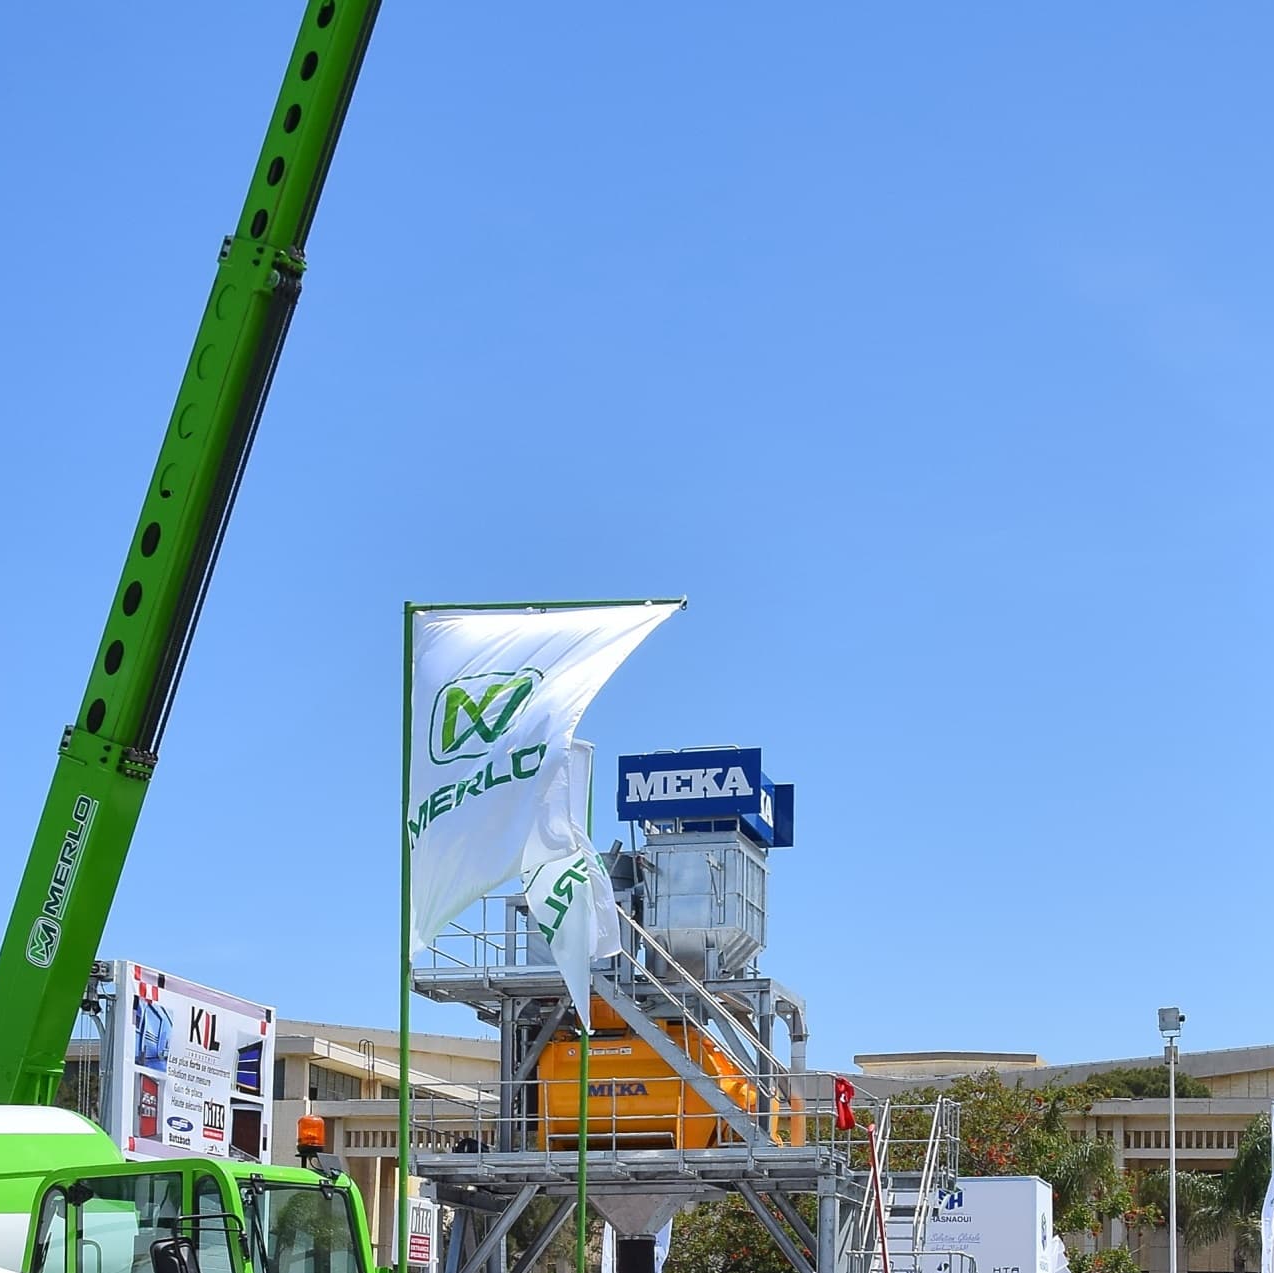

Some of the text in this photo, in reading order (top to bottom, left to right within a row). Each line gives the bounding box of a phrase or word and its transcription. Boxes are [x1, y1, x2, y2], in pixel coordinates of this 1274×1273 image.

[626, 767, 754, 802] MEKA
[43, 796, 91, 917] MERLO
[189, 1006, 220, 1051] KIL
[588, 1083, 649, 1096] MEKA
